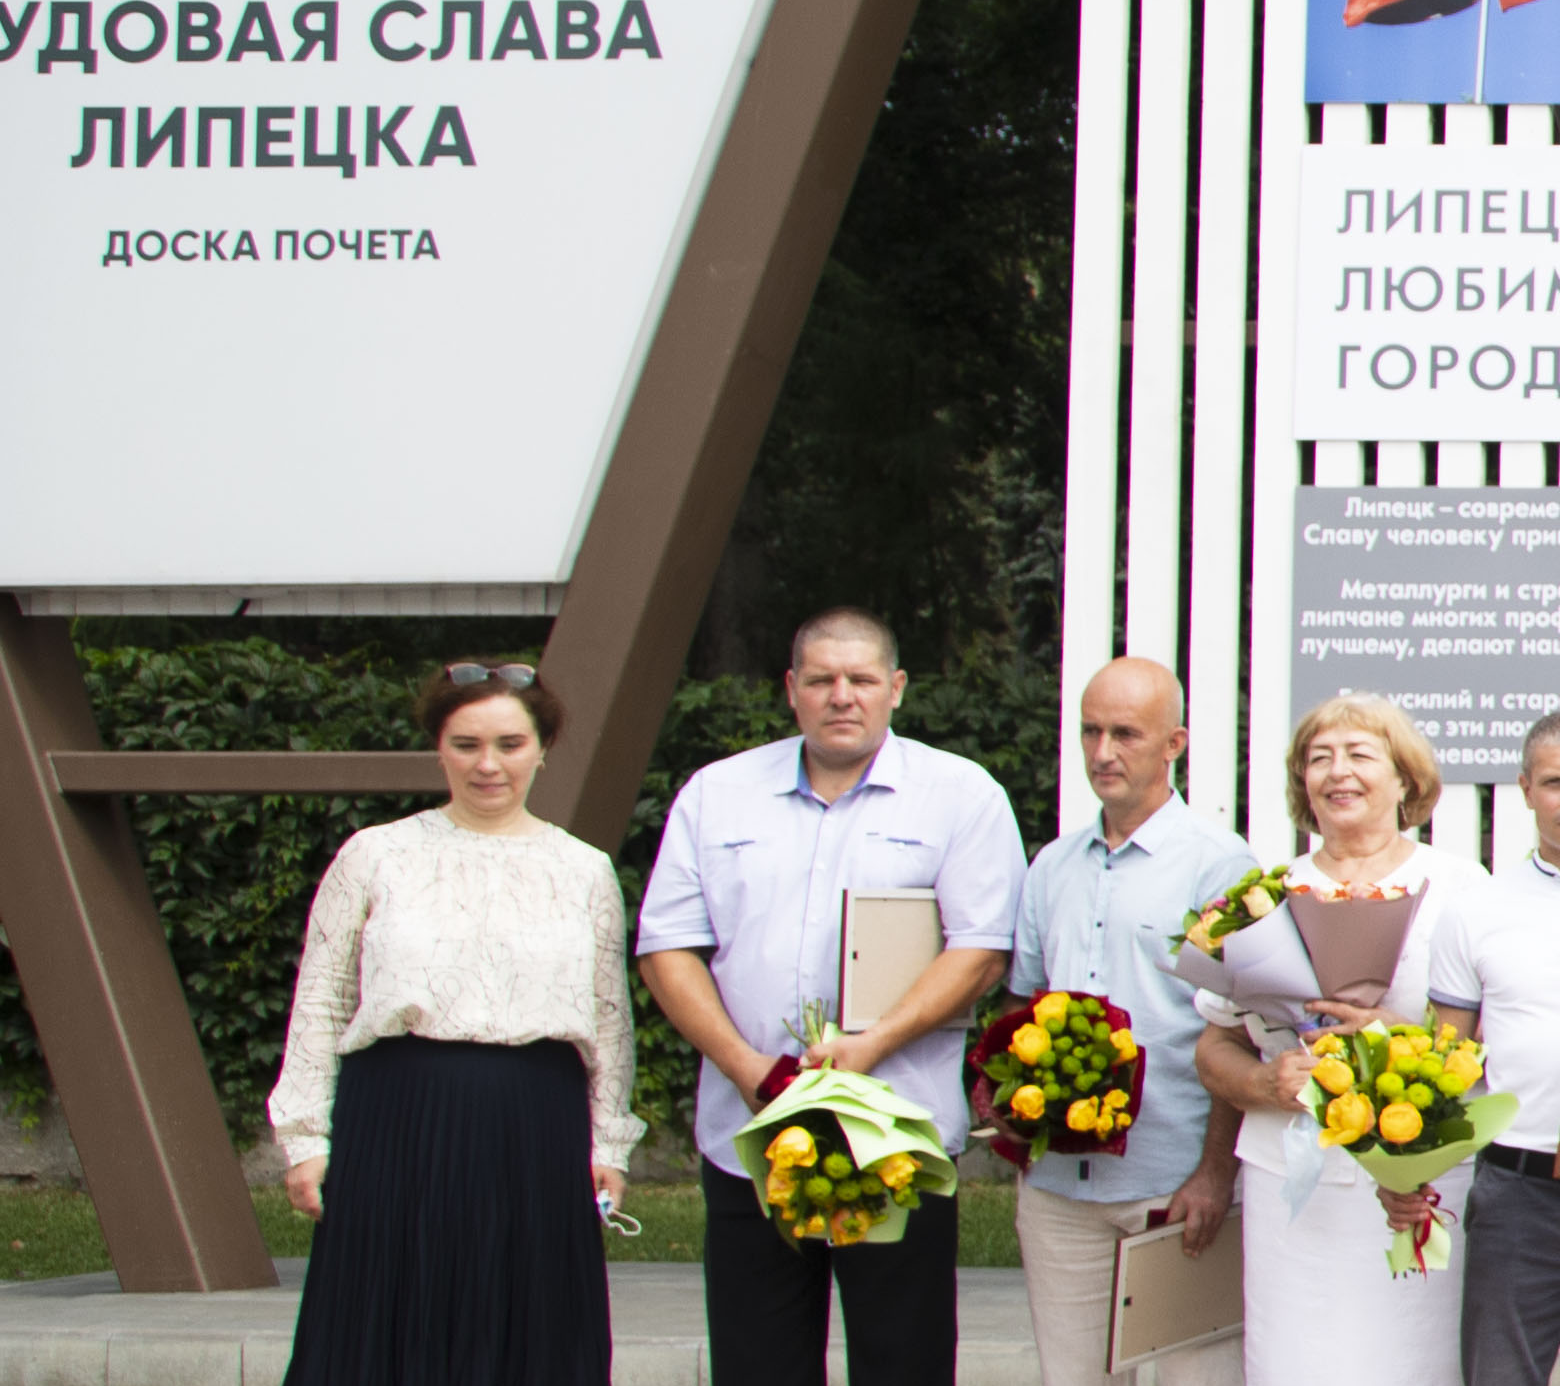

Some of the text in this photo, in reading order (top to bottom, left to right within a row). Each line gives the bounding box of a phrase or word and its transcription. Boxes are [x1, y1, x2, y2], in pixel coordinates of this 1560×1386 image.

[369, 0, 662, 61] СЛАВА
[71, 105, 477, 179] ЛИПЕЦКА
[103, 229, 440, 267] ДОСКА ПОЧЕТА
[1345, 497, 1434, 520] Липецк
[1304, 524, 1378, 551] Славу
[1387, 529, 1503, 552] человеку
[1341, 579, 1486, 606] Металлурги
[1496, 584, 1509, 599] и
[1302, 610, 1404, 627] липчане
[1412, 610, 1496, 627] многих
[1301, 638, 1414, 661] лучшему,
[1422, 638, 1515, 657] делают
[1388, 689, 1472, 709] усилий
[1481, 692, 1495, 709] и
[1446, 720, 1483, 737] эти
